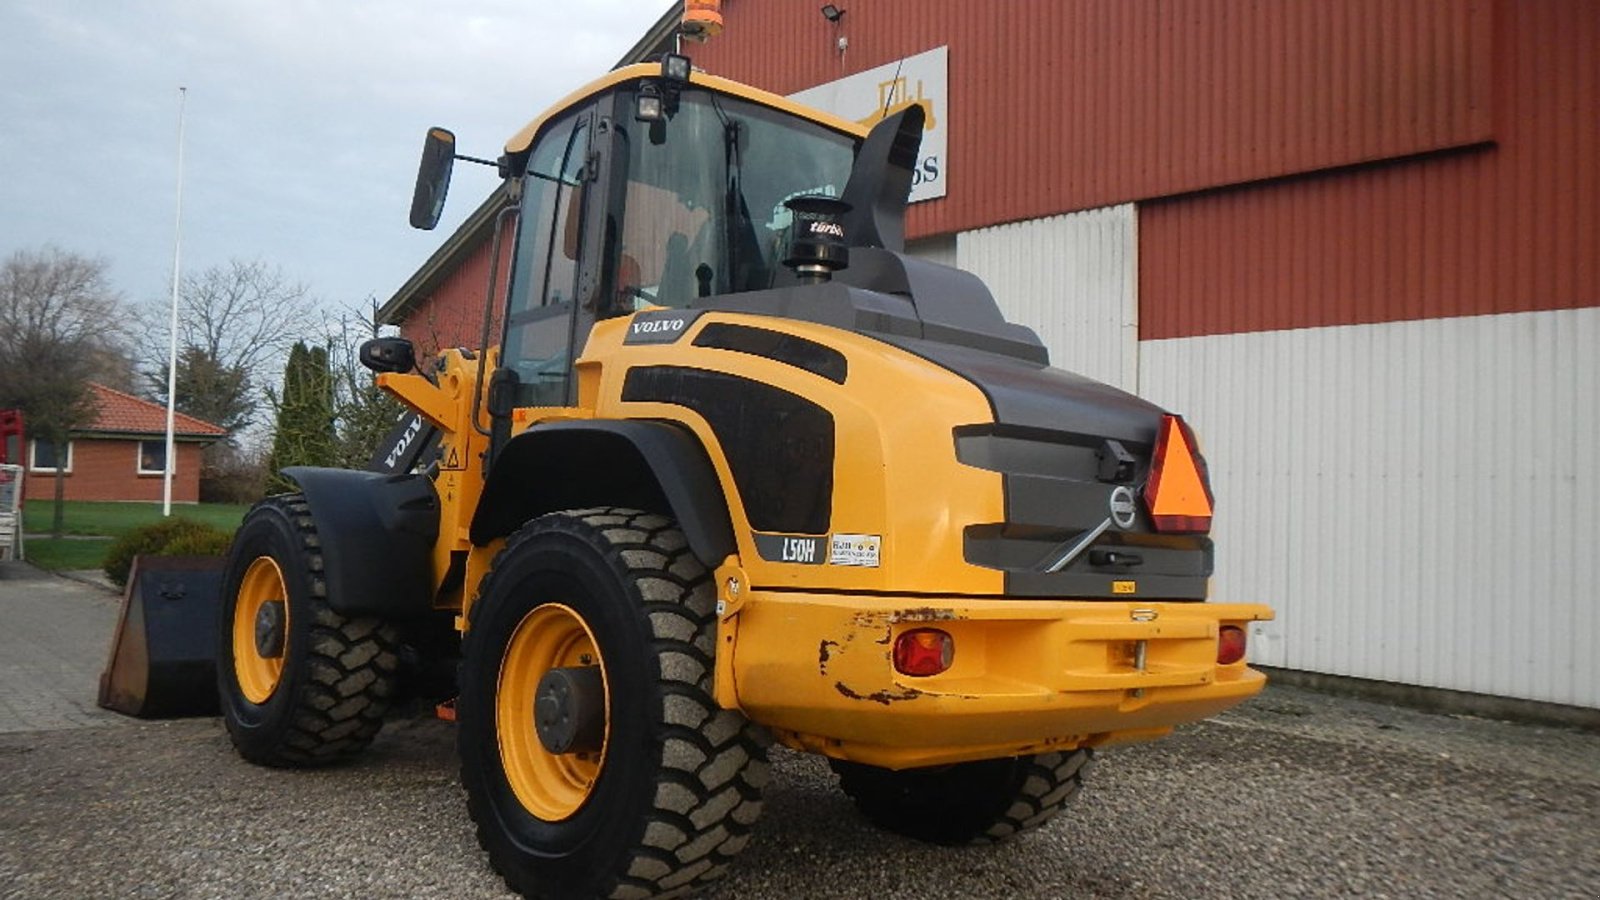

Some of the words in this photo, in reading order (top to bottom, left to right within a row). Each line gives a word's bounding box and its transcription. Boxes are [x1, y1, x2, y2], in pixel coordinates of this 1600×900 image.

[633, 319, 684, 334] VOLVO
[384, 413, 422, 469] VOLV
[782, 537, 816, 562] L50H
